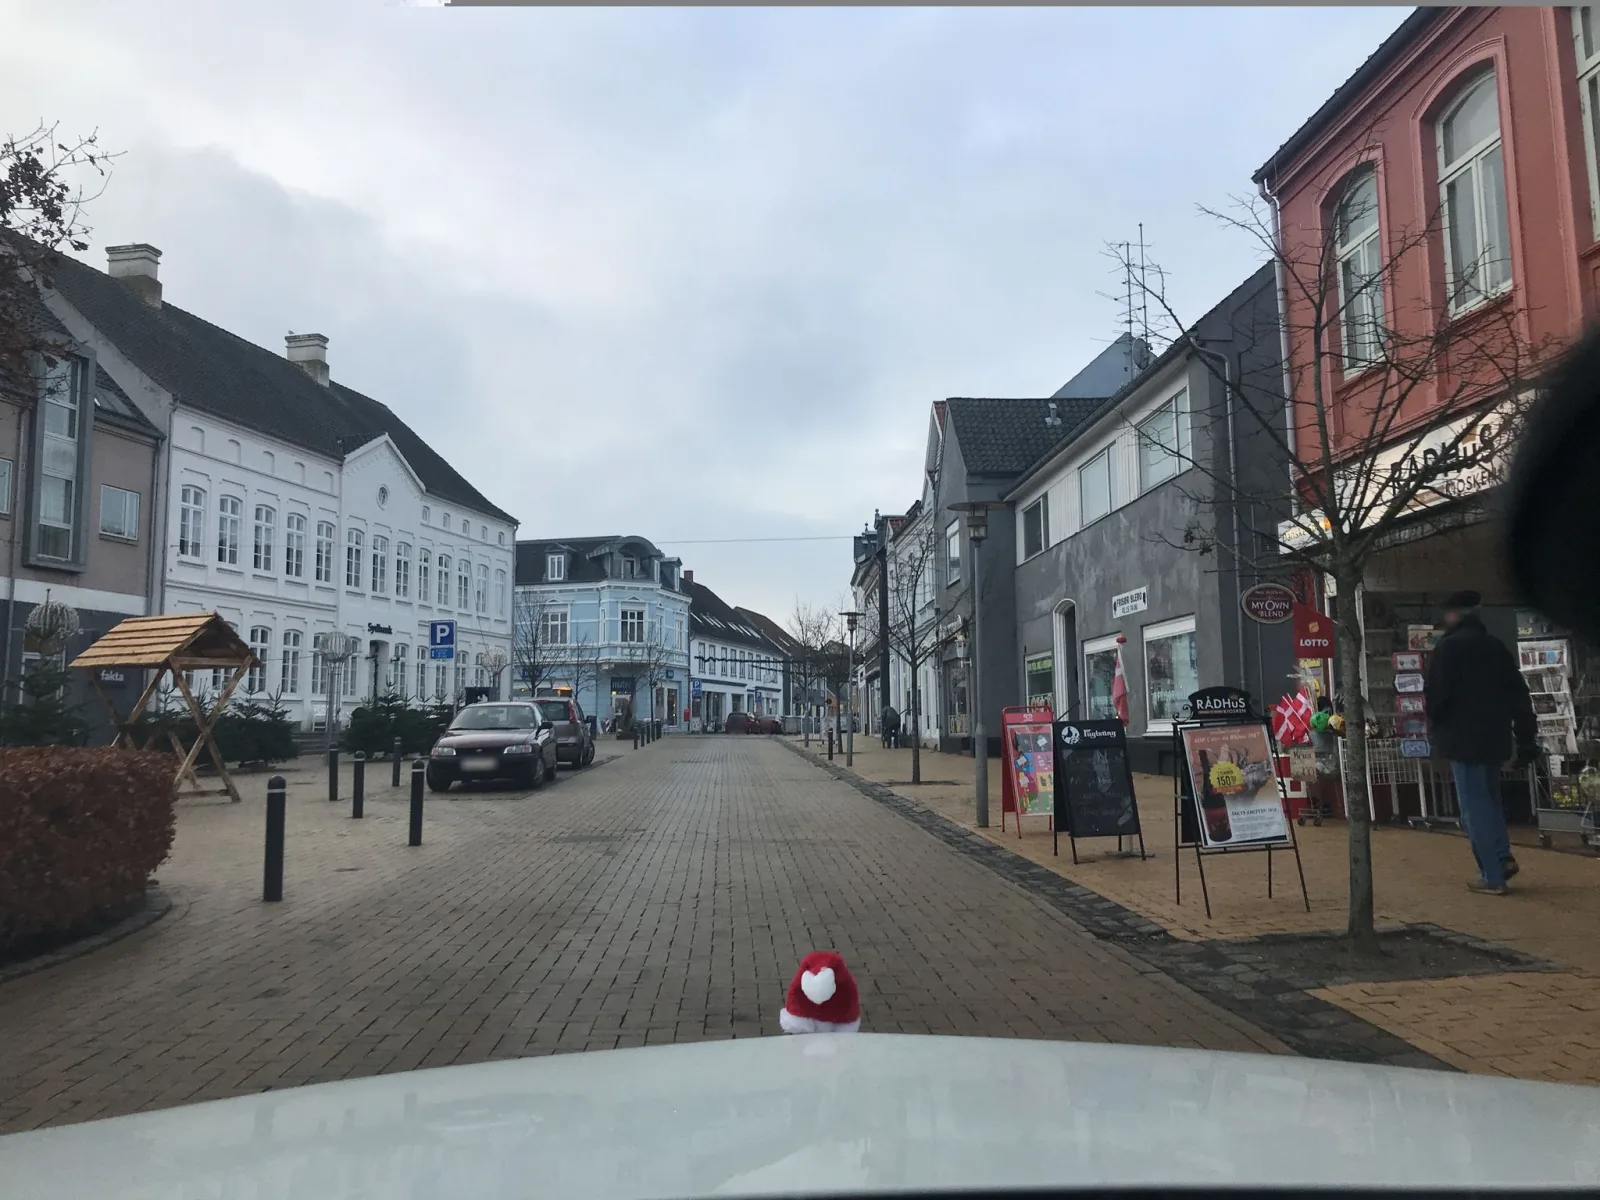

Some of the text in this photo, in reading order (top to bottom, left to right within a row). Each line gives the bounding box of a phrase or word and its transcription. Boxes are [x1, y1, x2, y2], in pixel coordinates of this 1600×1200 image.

[1251, 600, 1289, 611] MY OWN
[436, 624, 450, 644] P
[1300, 639, 1329, 647] LOTTO
[101, 670, 124, 681] fakta
